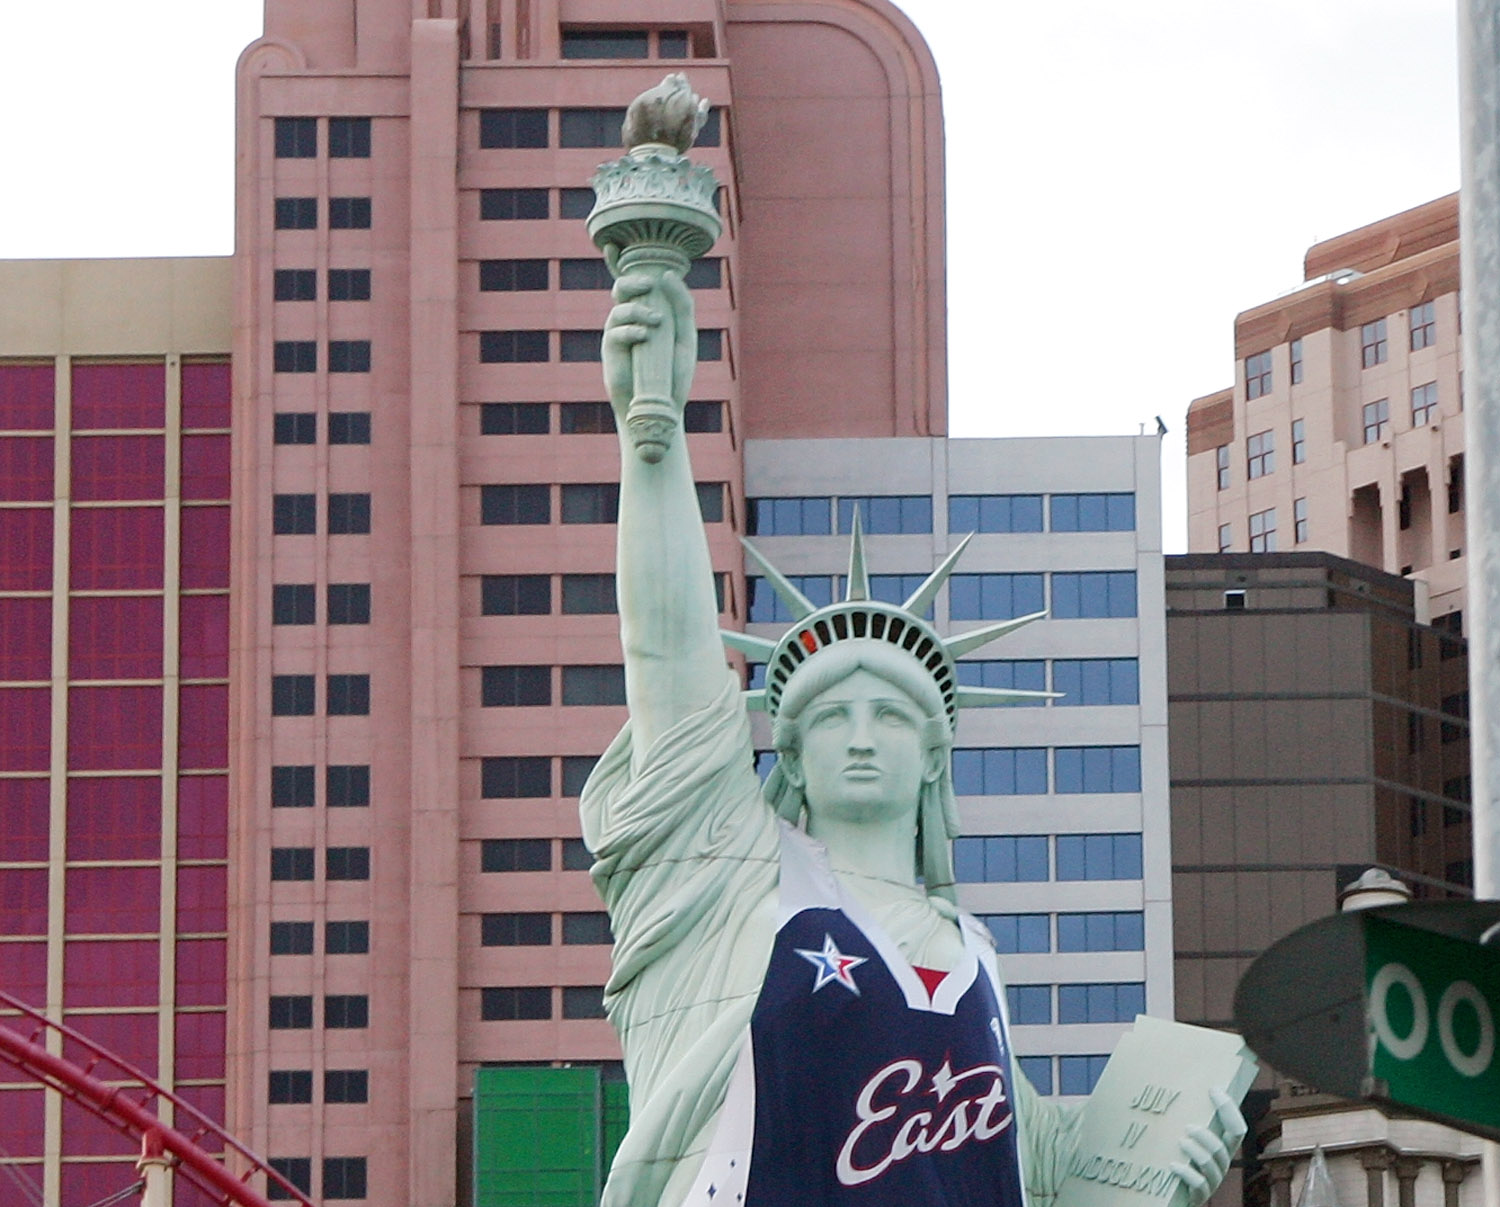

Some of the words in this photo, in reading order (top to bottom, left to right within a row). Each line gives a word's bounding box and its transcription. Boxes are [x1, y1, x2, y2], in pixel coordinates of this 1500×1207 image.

[1130, 1084, 1181, 1115] JULY
[835, 1057, 1013, 1187] East
[1120, 1121, 1148, 1149] IV
